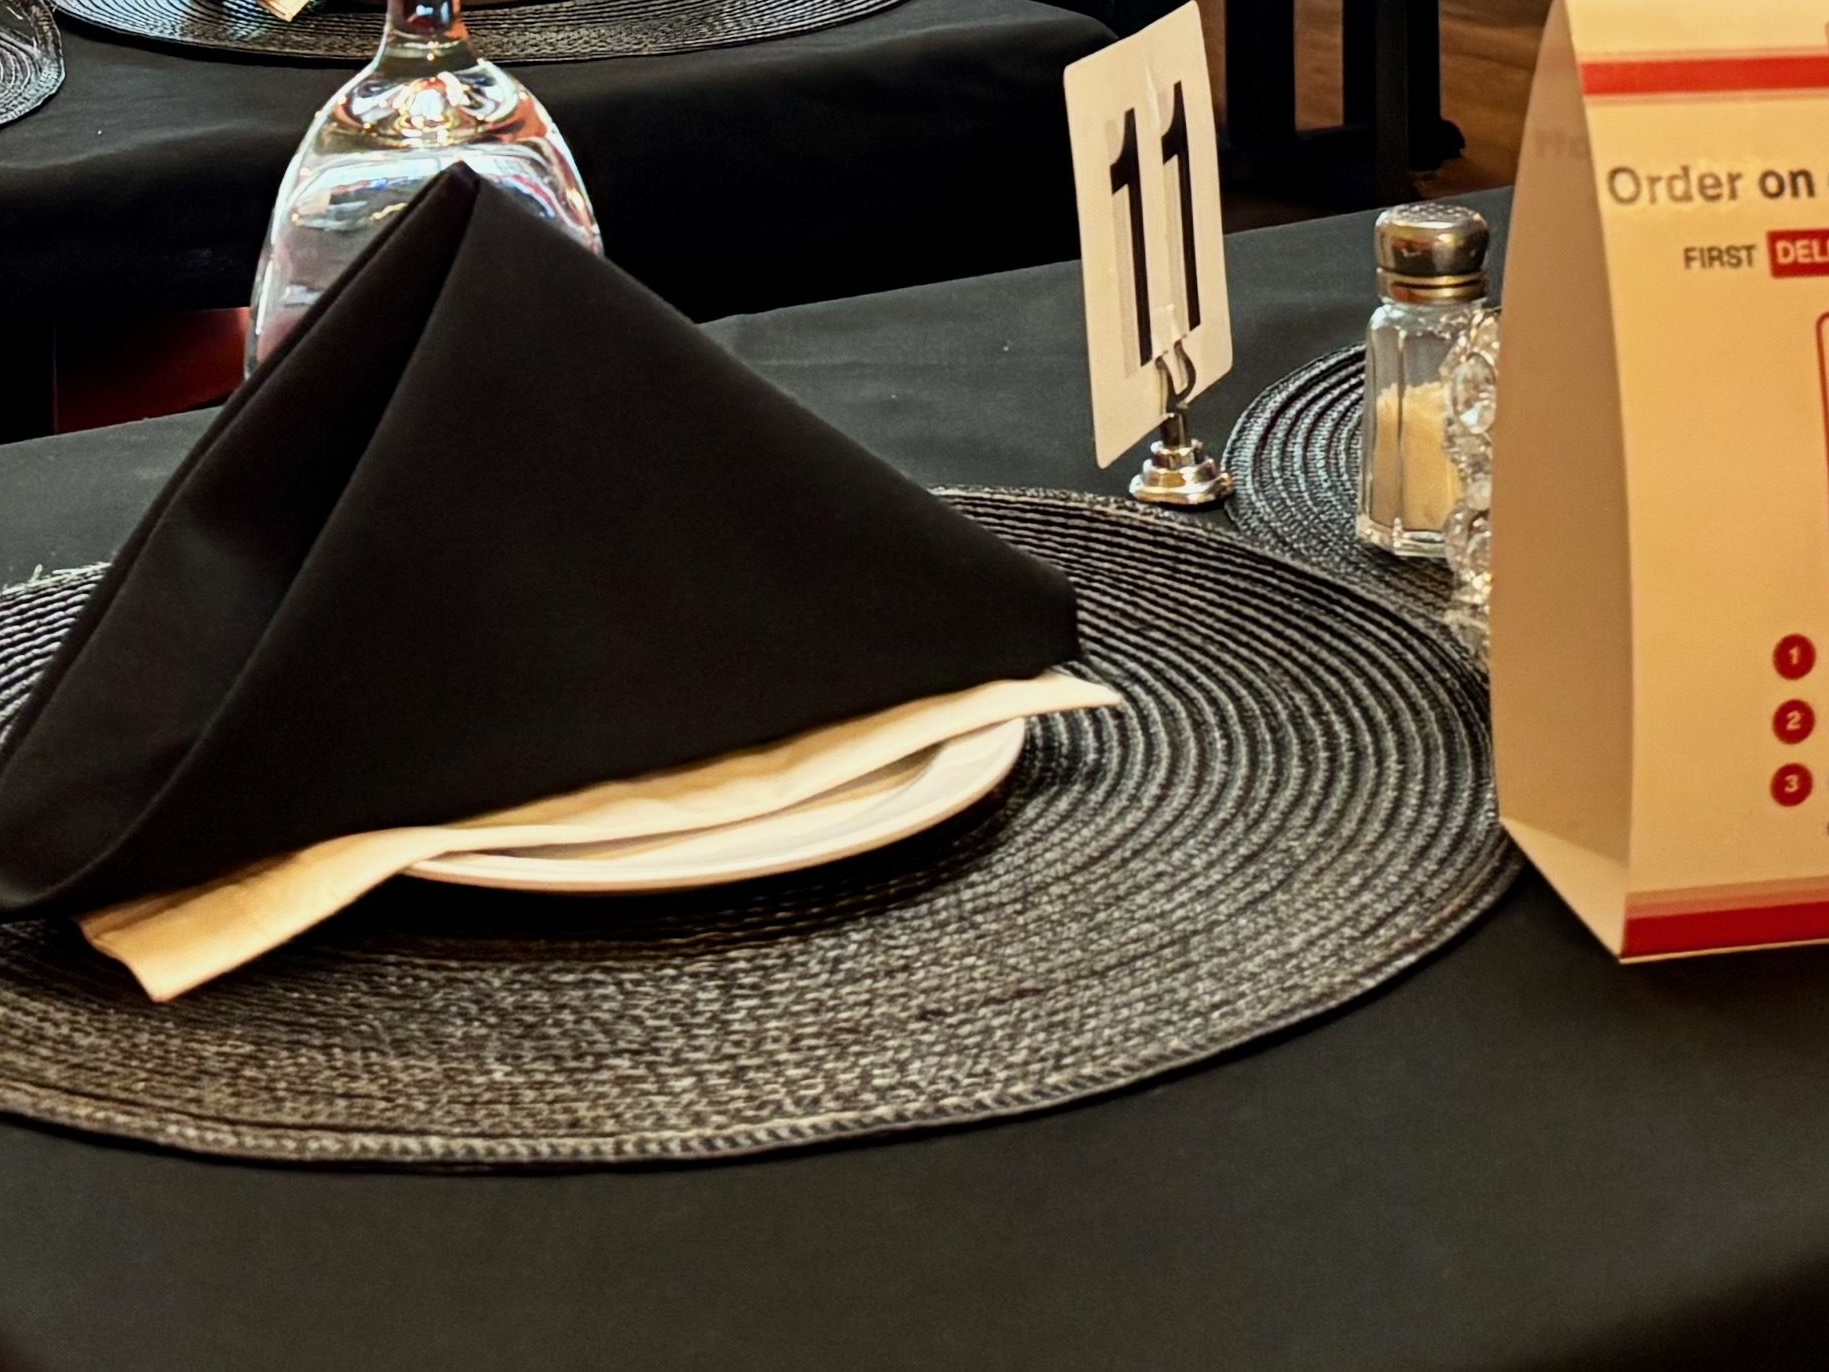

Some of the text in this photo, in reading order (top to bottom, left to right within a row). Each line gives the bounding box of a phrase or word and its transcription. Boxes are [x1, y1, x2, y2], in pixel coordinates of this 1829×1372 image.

[1606, 164, 1743, 205] Order
[1758, 168, 1816, 200] on
[1109, 80, 1201, 367] 11
[1683, 244, 1757, 269] FIRST
[1788, 645, 1801, 666] 1
[1785, 709, 1803, 732] 2
[1783, 773, 1800, 794] 3
